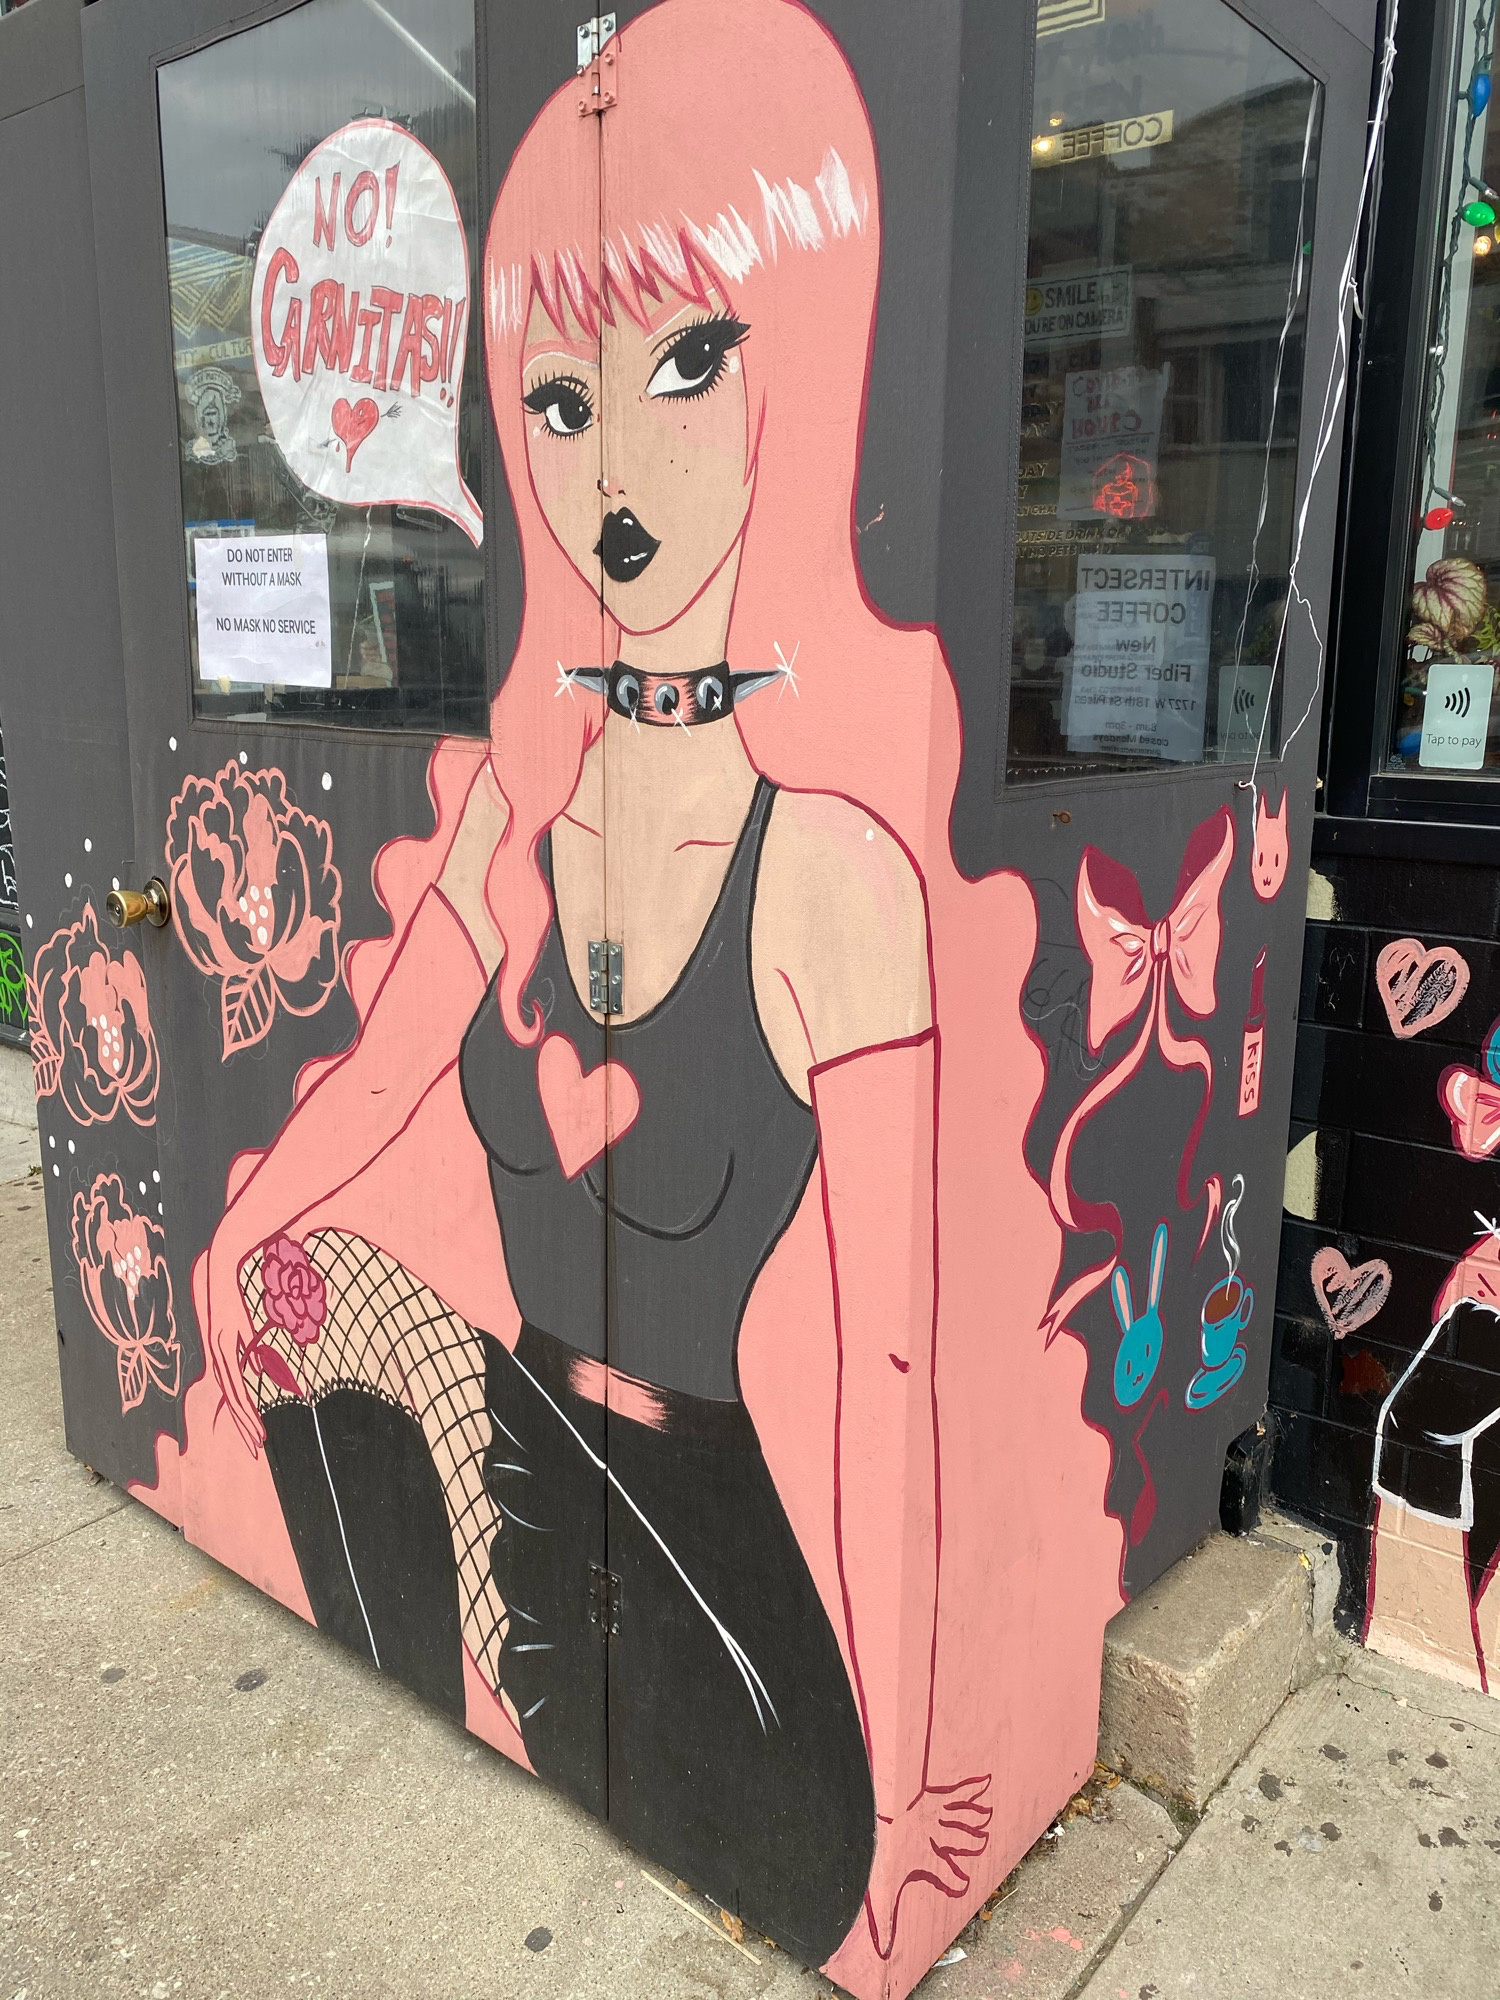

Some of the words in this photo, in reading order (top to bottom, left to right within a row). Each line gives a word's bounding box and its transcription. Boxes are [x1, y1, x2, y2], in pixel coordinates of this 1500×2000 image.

[313, 161, 400, 251] NO!
[1045, 282, 1097, 308] SMILE
[1058, 313, 1074, 330] ON
[209, 340, 253, 361] CULTUR
[227, 549, 242, 563] DO
[245, 548, 265, 563] NOT
[268, 548, 293, 562] ENTER
[222, 572, 268, 586] WITHOUT
[269, 573, 276, 586] A
[277, 572, 302, 587] MASK
[216, 618, 231, 632] NO
[234, 618, 261, 633] MASK
[263, 619, 276, 633] NO
[278, 620, 316, 635] SERVICE
[1426, 733, 1445, 747] Tap
[1447, 735, 1459, 745] to
[1461, 736, 1482, 749] pay
